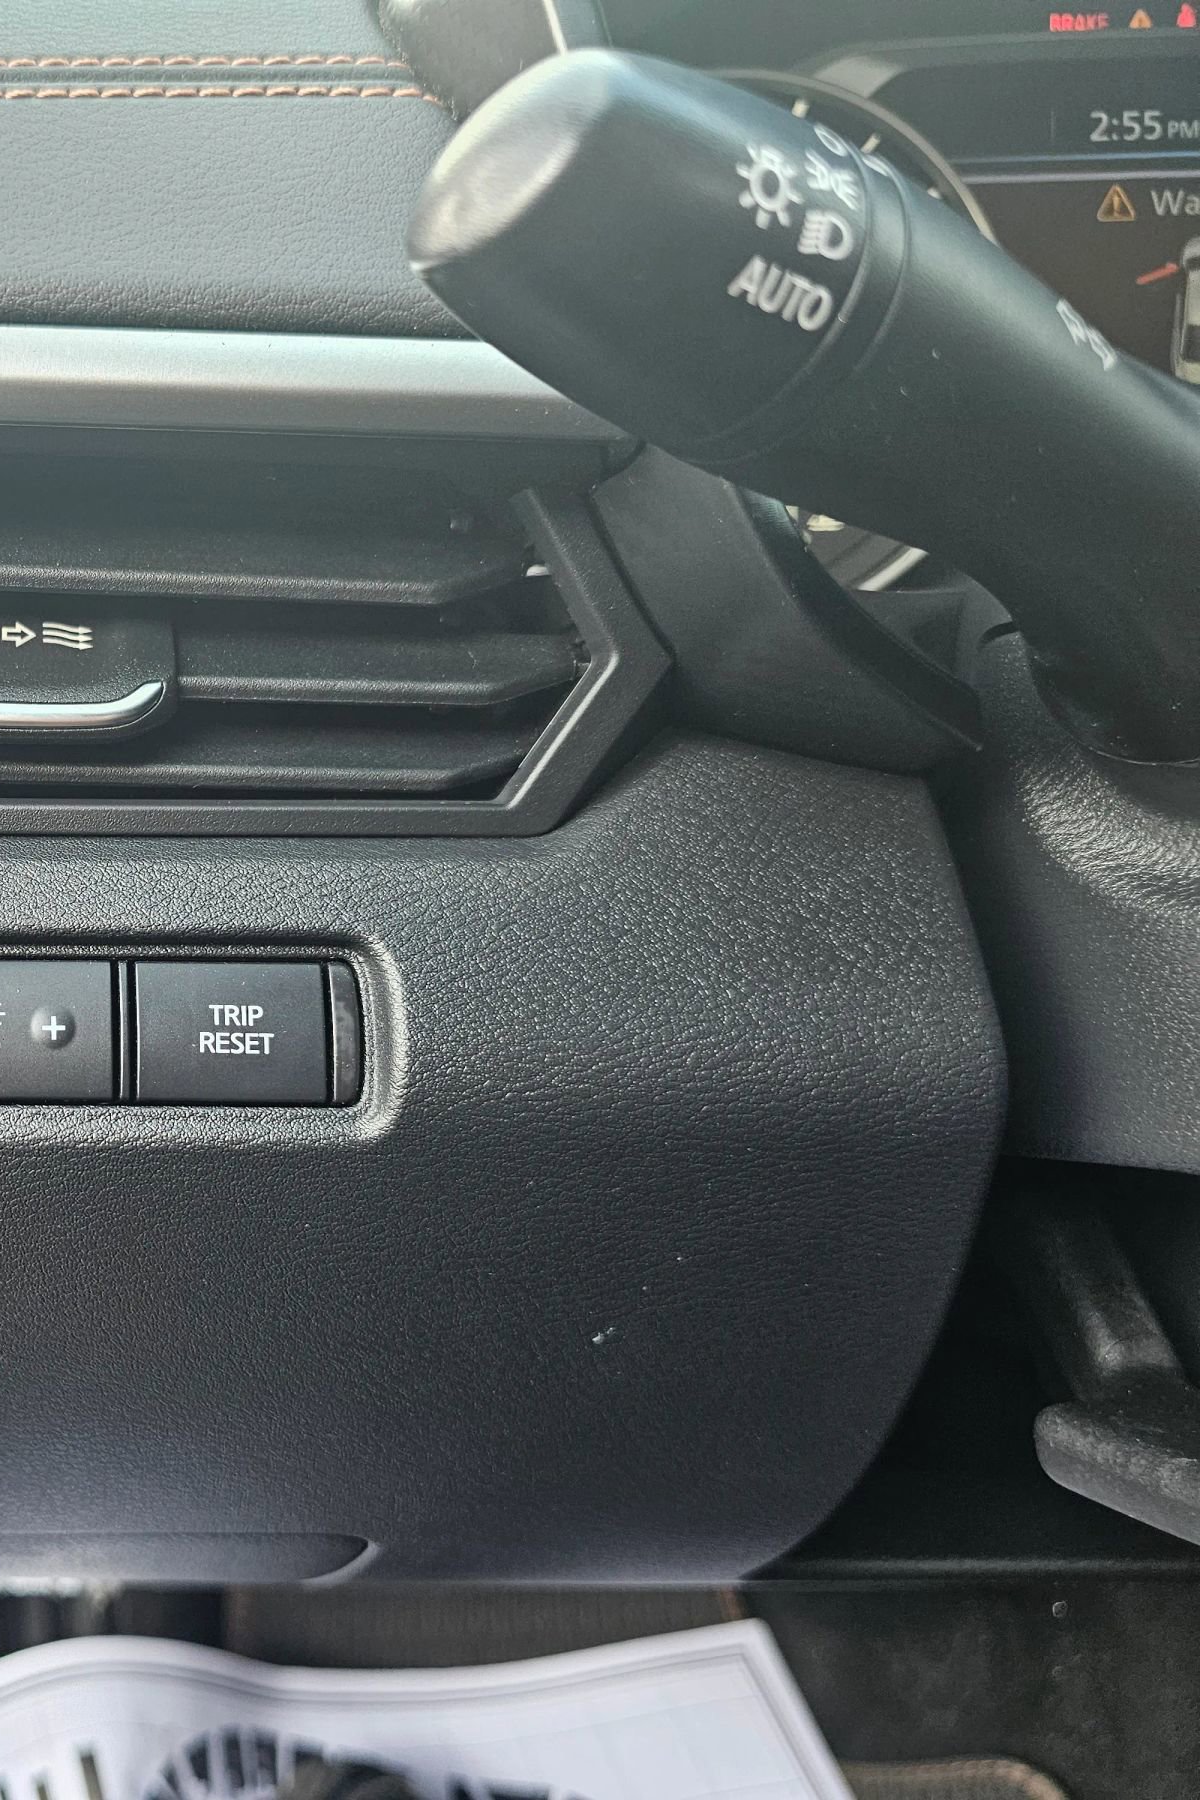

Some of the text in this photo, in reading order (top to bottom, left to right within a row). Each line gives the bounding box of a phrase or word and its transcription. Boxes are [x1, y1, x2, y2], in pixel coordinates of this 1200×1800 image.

[1090, 111, 1200, 142] 2:55 PM
[728, 255, 832, 331] AUTO
[208, 1004, 264, 1027] TRIP
[199, 1031, 275, 1055] RESET
